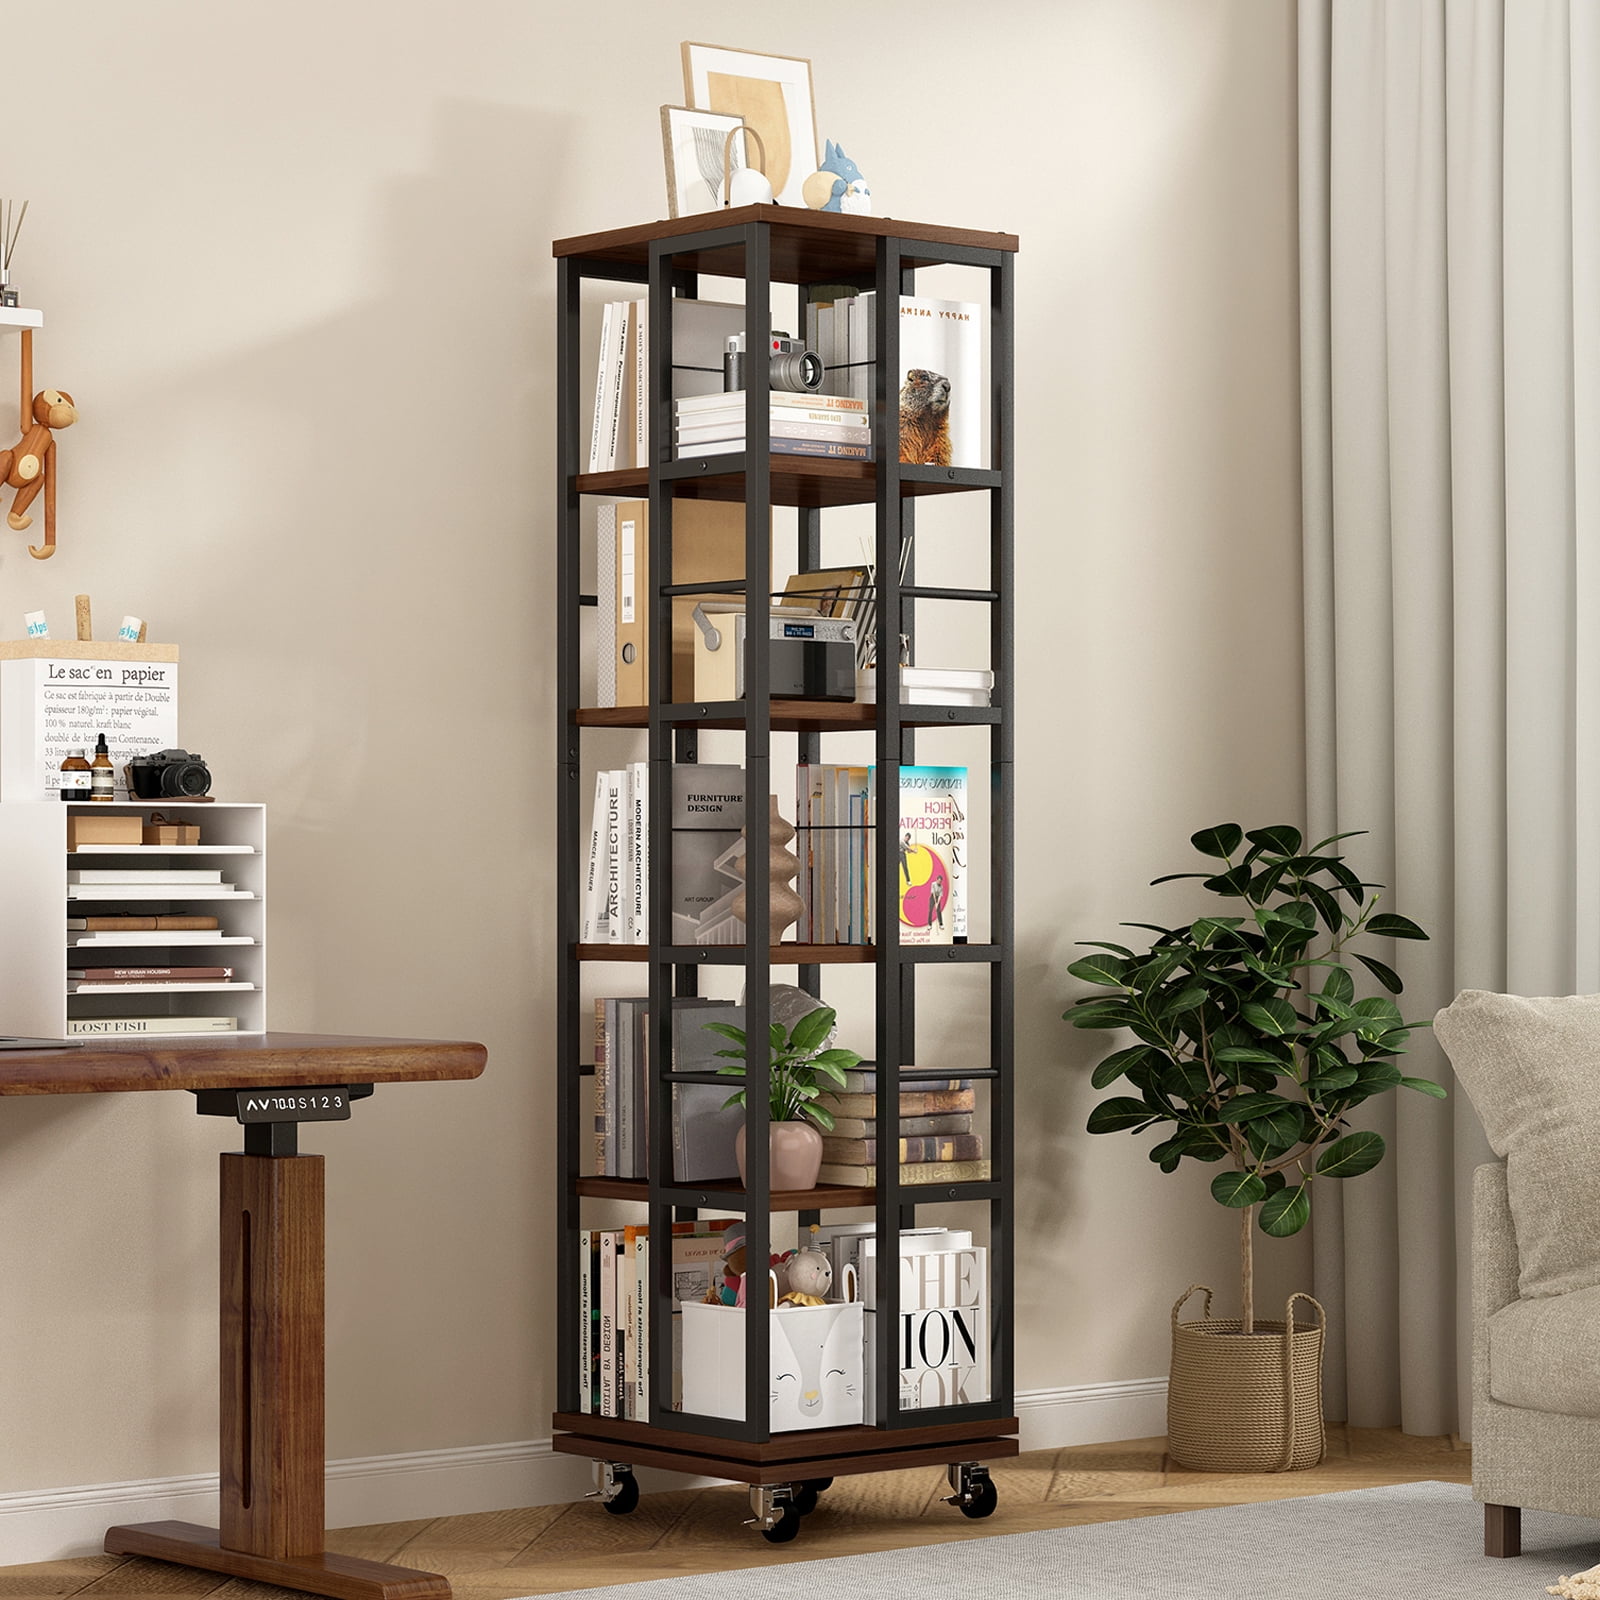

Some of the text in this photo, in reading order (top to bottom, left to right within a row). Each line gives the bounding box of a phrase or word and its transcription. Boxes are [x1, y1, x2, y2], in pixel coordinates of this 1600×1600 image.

[826, 398, 834, 407] IT
[835, 400, 864, 410] MAKING
[828, 444, 836, 454] IT
[838, 446, 866, 456] MAKING
[48, 664, 166, 684] Le sac en papier
[44, 690, 54, 700] Ce
[114, 692, 134, 703] partir
[134, 692, 144, 702] de
[144, 692, 170, 702] Double
[44, 704, 76, 716] épaisseur
[111, 706, 132, 718] papier
[45, 719, 57, 728] 100
[58, 720, 66, 728] %
[96, 719, 112, 728] kraft
[113, 720, 132, 729] blanc
[44, 732, 70, 742] doublé
[72, 732, 81, 742] de
[84, 732, 98, 742] kraf
[687, 794, 743, 803] FURNITURE
[687, 804, 723, 813] DESIGN
[610, 787, 618, 918] ARCHITECTURE
[73, 1022, 147, 1033] LOST FISH
[298, 1096, 342, 1110] S 1 2 3
[901, 1308, 980, 1370] ION
[900, 1366, 976, 1408] OK
